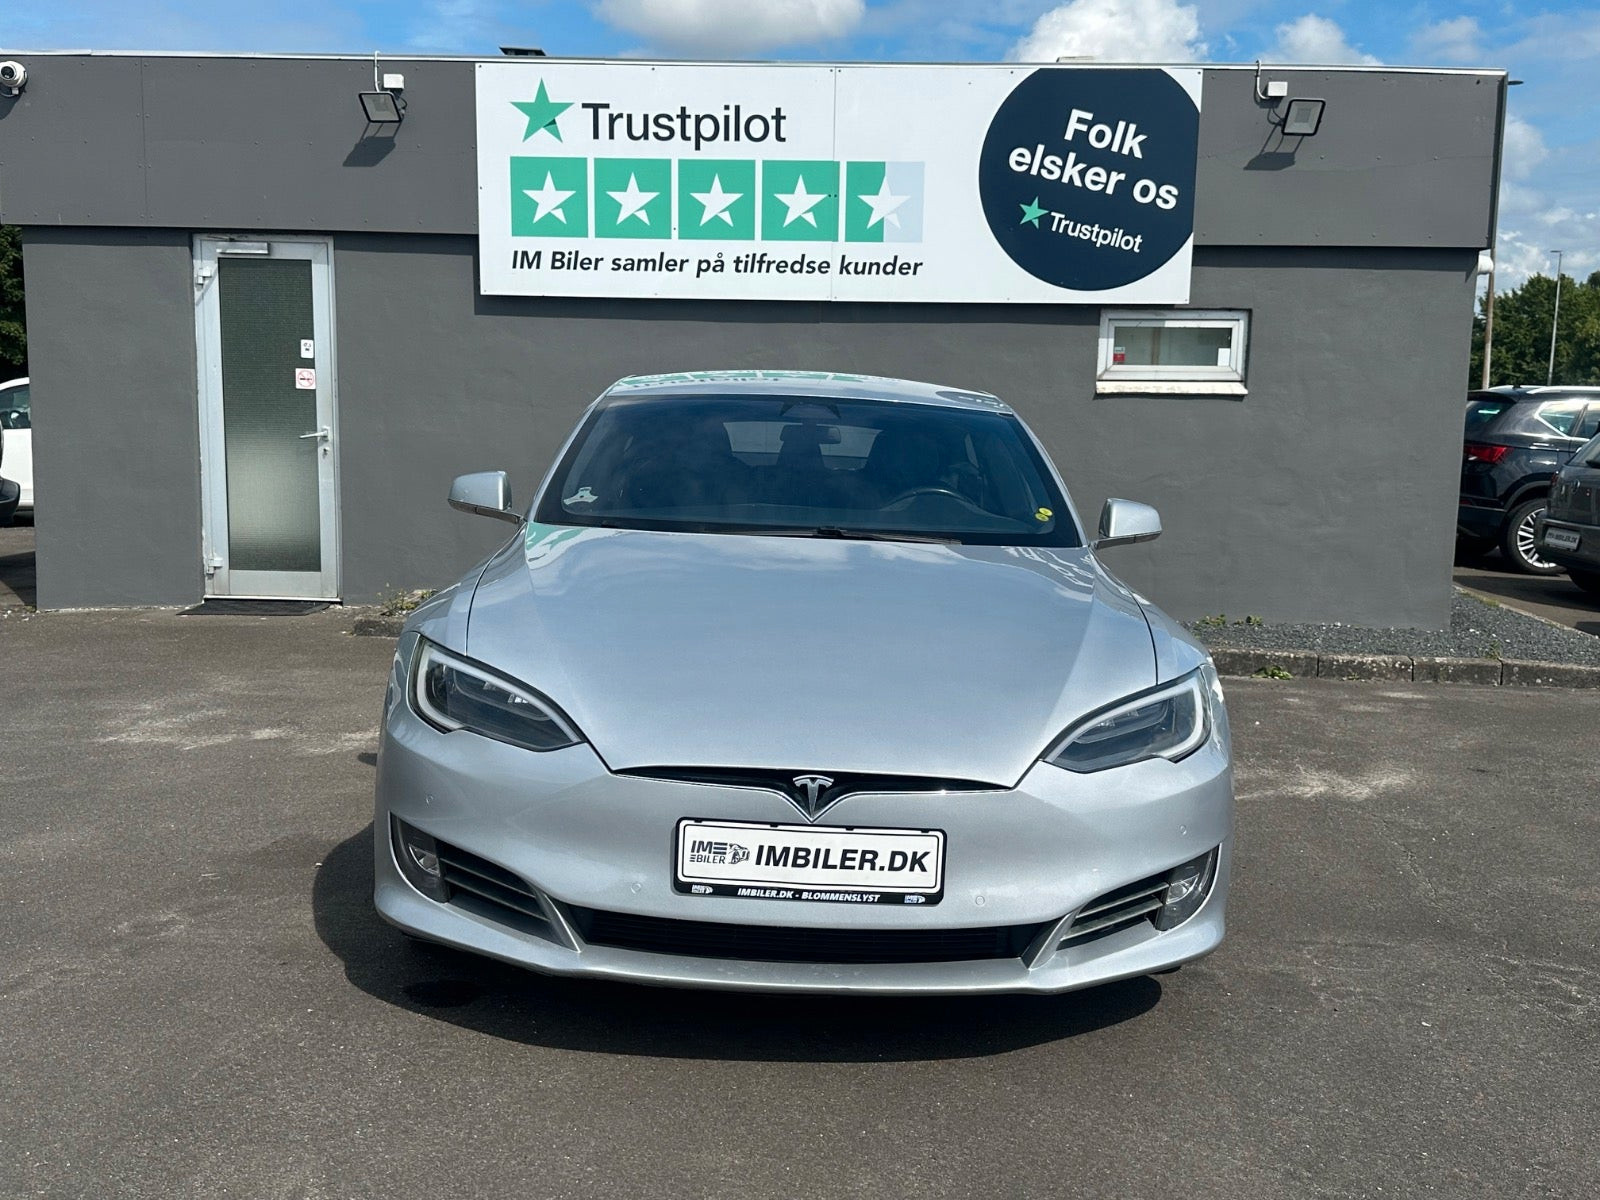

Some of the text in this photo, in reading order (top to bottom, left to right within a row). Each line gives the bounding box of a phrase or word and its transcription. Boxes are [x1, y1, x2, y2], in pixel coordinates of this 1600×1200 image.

[581, 102, 787, 151] Trustpilot
[1063, 108, 1148, 159] Folk
[1008, 143, 1179, 210] elsker os
[1050, 211, 1143, 253] Trustpilot
[511, 250, 924, 278] IM Biler samler på tilfredse kunder
[755, 844, 931, 873] IMBILER.DK
[737, 887, 793, 899] IMBILER.DK
[801, 891, 881, 903] BLOMMENSLYST
